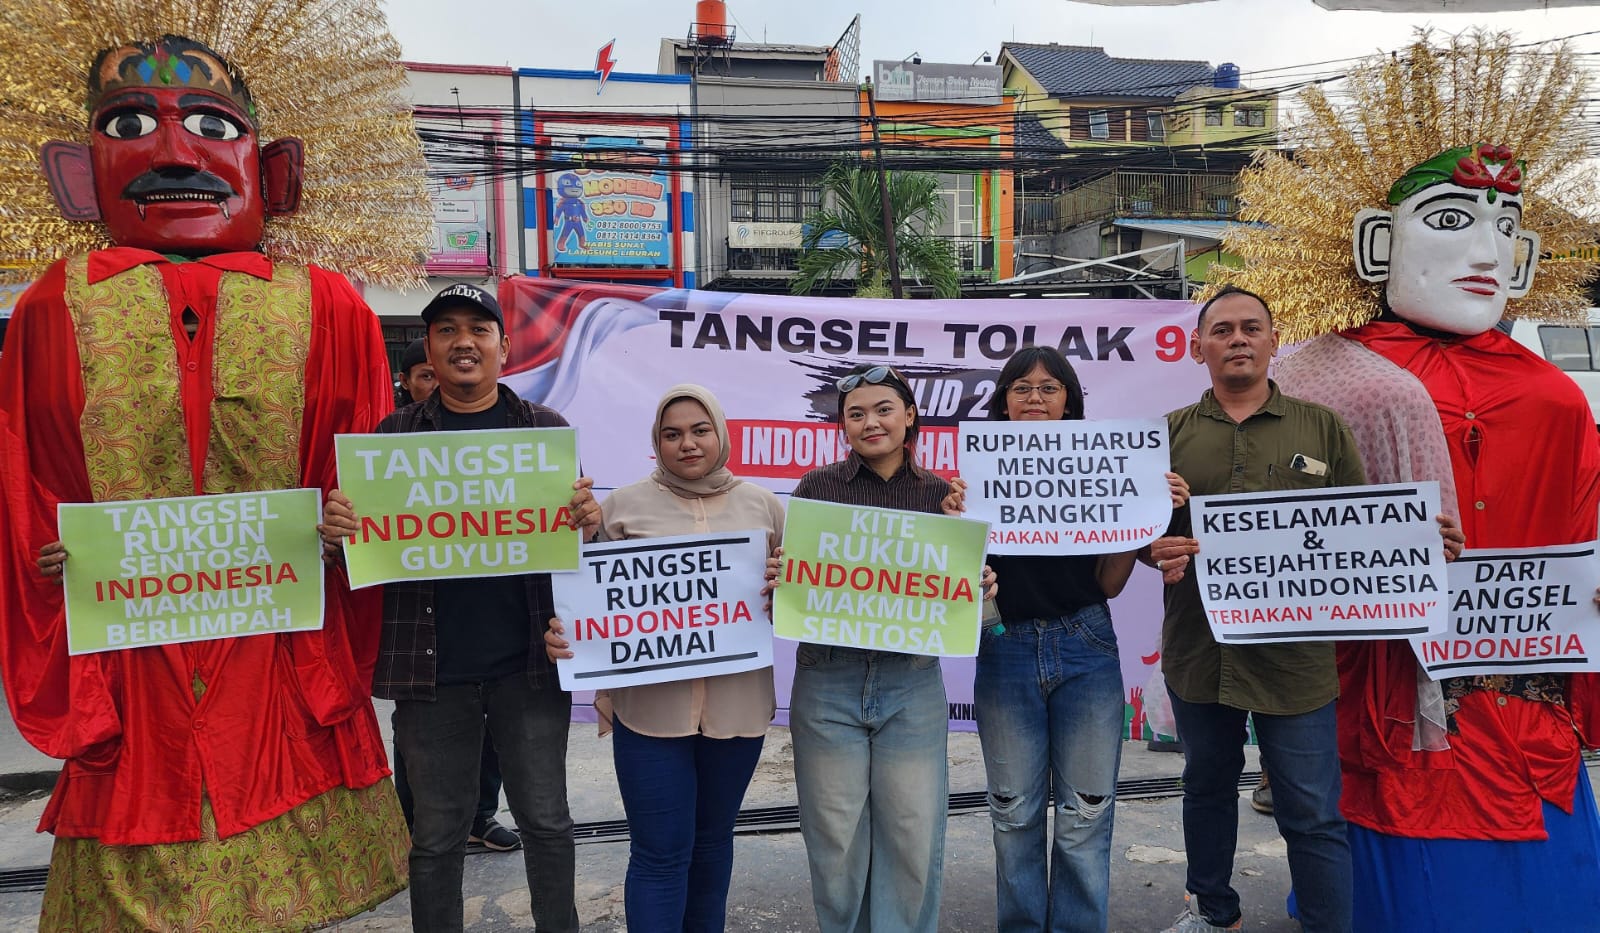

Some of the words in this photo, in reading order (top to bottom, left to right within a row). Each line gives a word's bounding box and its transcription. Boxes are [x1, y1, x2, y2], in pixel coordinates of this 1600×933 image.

[659, 310, 924, 357] TANGSEL
[1155, 325, 1199, 362] 9
[908, 378, 963, 417] LID
[966, 433, 1062, 453] RUPIAH
[1072, 430, 1161, 451] HARUS
[355, 442, 560, 481] TANGSEL
[998, 455, 1129, 476] MENGUAT
[405, 477, 516, 508] ADEM
[984, 477, 1139, 499] INDONESIA
[104, 497, 279, 532] TANGSEL
[851, 509, 917, 539] KITE
[1000, 503, 1123, 524] BANGKIT
[1203, 501, 1428, 534] KESELAMATAN
[123, 521, 266, 556] RUKUN
[817, 531, 949, 572] RUKUN
[989, 530, 1060, 545] RIAKAN
[1303, 530, 1325, 550] &
[120, 545, 273, 578] SENTOSA
[401, 541, 529, 571] GUYUB
[589, 549, 731, 584] TANGSEL
[1206, 547, 1430, 578] KESEJAHTERAAN
[1475, 560, 1546, 583] DARI
[95, 562, 298, 602] INDONESIA
[606, 577, 718, 611] RUKUN
[785, 558, 974, 603] INDONESIA
[1207, 581, 1268, 601] BAGI
[1278, 573, 1438, 598] INDONESIA
[124, 586, 275, 619] MAKMUR
[806, 588, 949, 626] MAKMUR
[1448, 584, 1577, 612] ANGSEL
[106, 607, 292, 645] BERLIMPAH
[575, 600, 752, 641] INDONESIA
[1209, 605, 1313, 625] TERIAKAN
[1456, 612, 1552, 635] UNTUK
[610, 630, 715, 665] DAMAI
[802, 616, 946, 654] SENTOSA
[1422, 633, 1585, 663] INDONESIA
